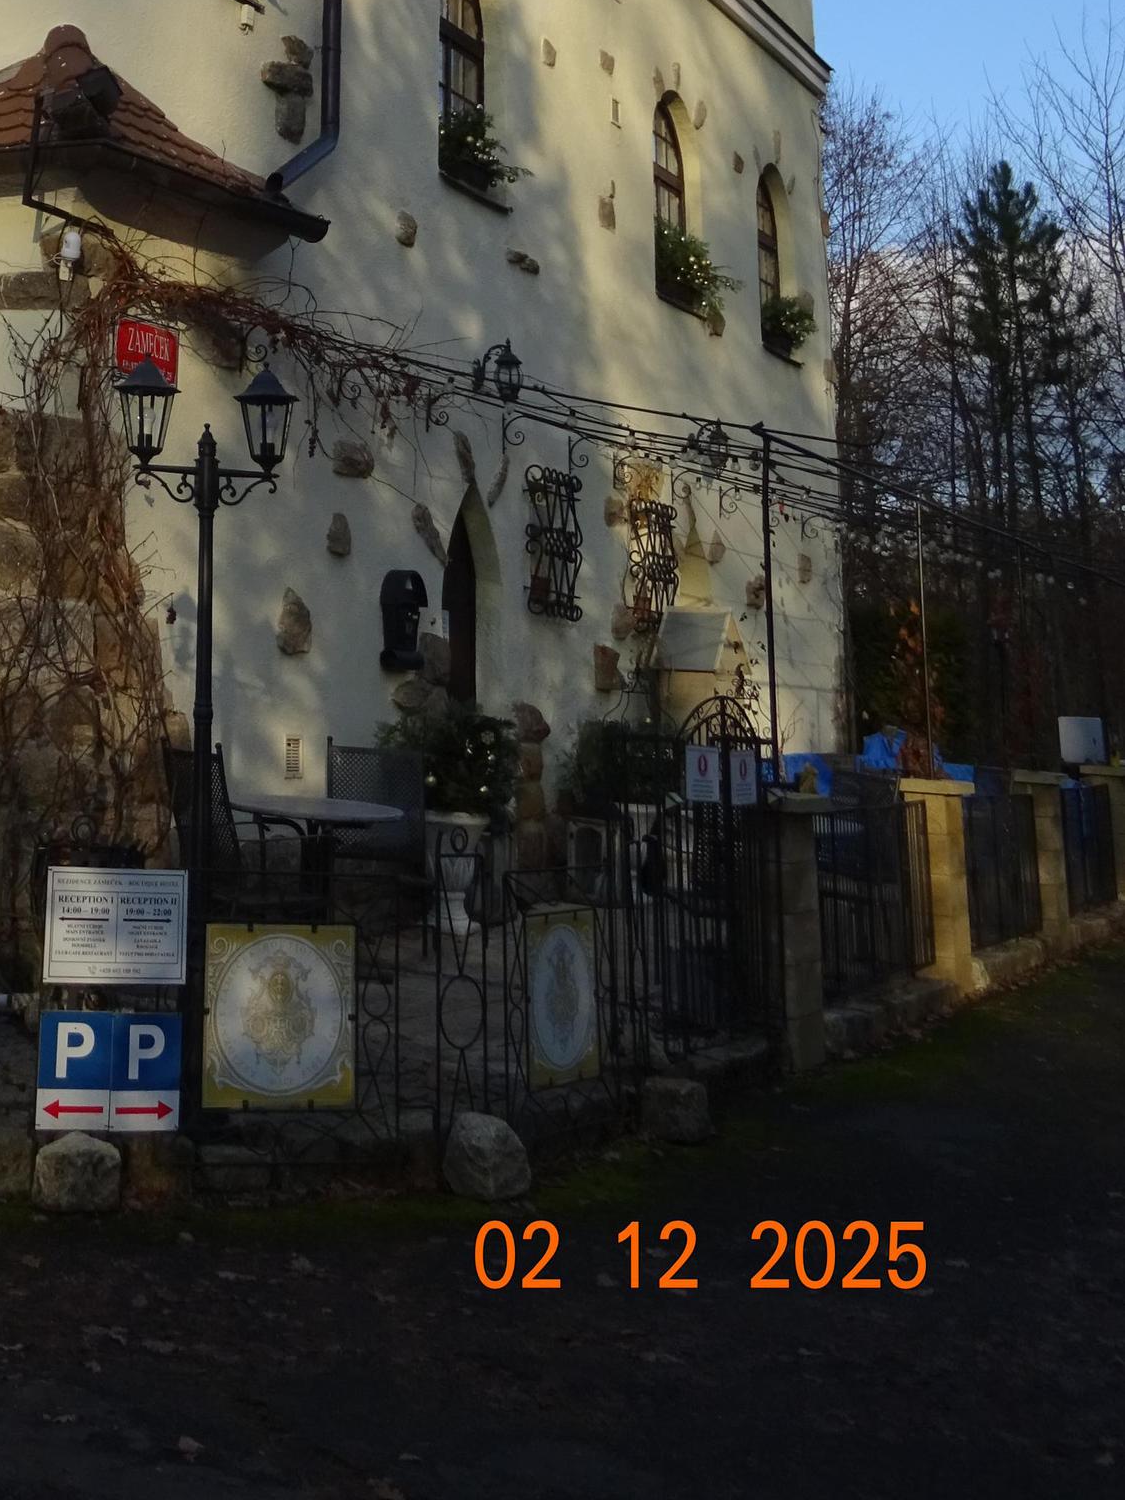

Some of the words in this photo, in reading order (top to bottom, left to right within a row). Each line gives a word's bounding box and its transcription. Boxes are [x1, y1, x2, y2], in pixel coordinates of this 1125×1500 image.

[58, 895, 108, 904] RECEPTION
[120, 896, 169, 906] RECEPTION
[62, 906, 82, 914] 14:00
[90, 907, 111, 915] 19:00
[125, 907, 145, 916] 19:00
[152, 908, 173, 916] 22:00
[55, 1022, 95, 1078] P
[128, 1024, 165, 1080] P
